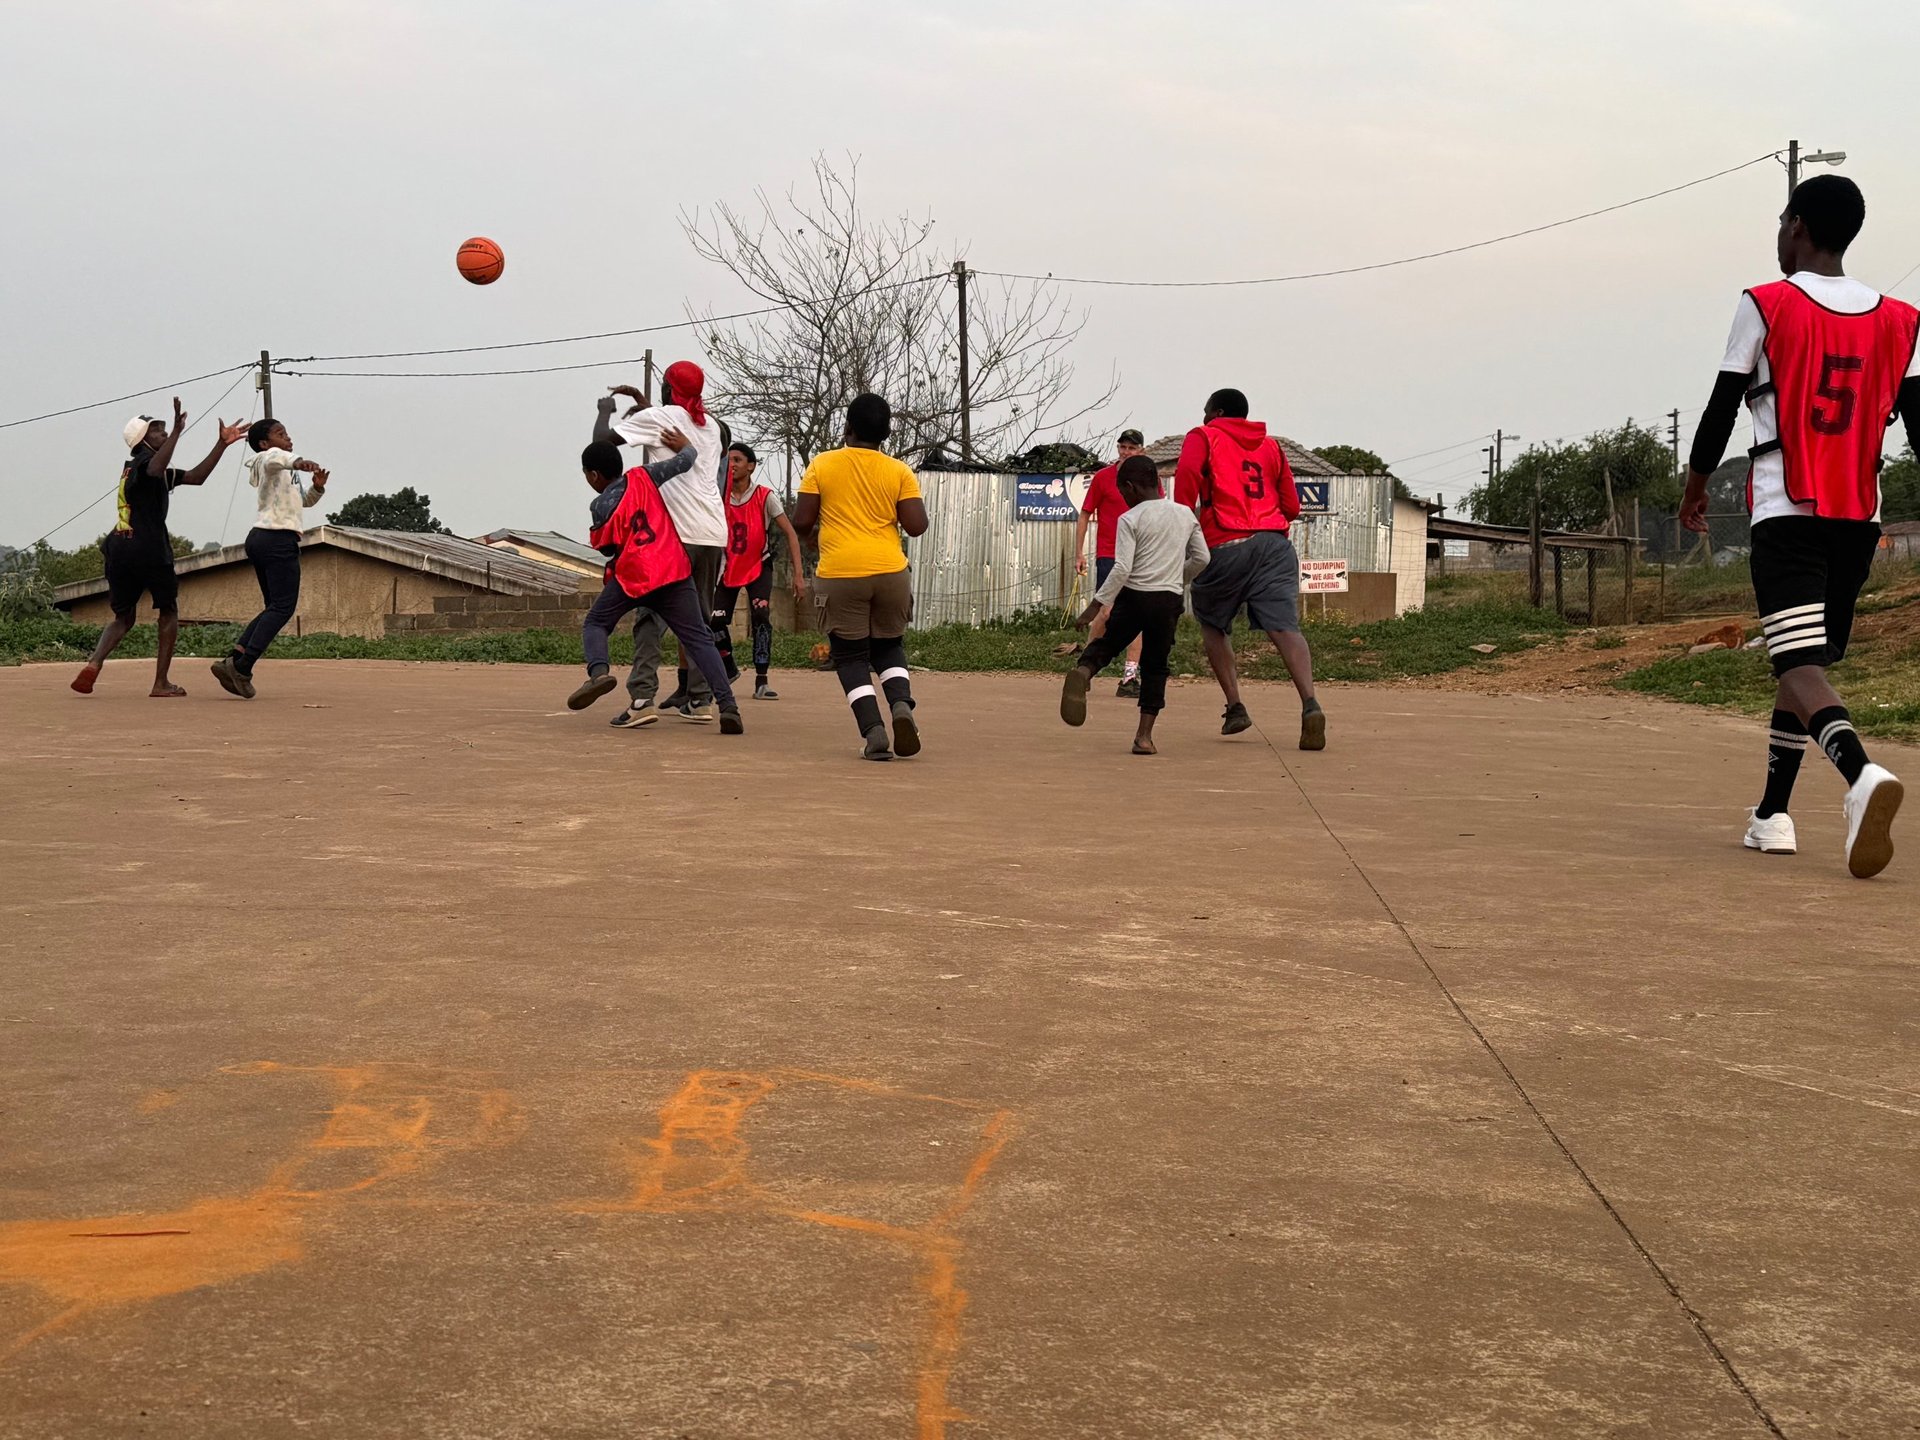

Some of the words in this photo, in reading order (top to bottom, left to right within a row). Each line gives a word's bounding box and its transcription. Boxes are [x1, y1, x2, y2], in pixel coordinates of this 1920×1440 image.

[1811, 354, 1864, 435] 5
[1242, 460, 1264, 498] 3
[1019, 506, 1045, 515] TUCK
[1047, 506, 1073, 515] SHOP
[732, 523, 748, 554] 8
[1312, 561, 1345, 570] DUMPING
